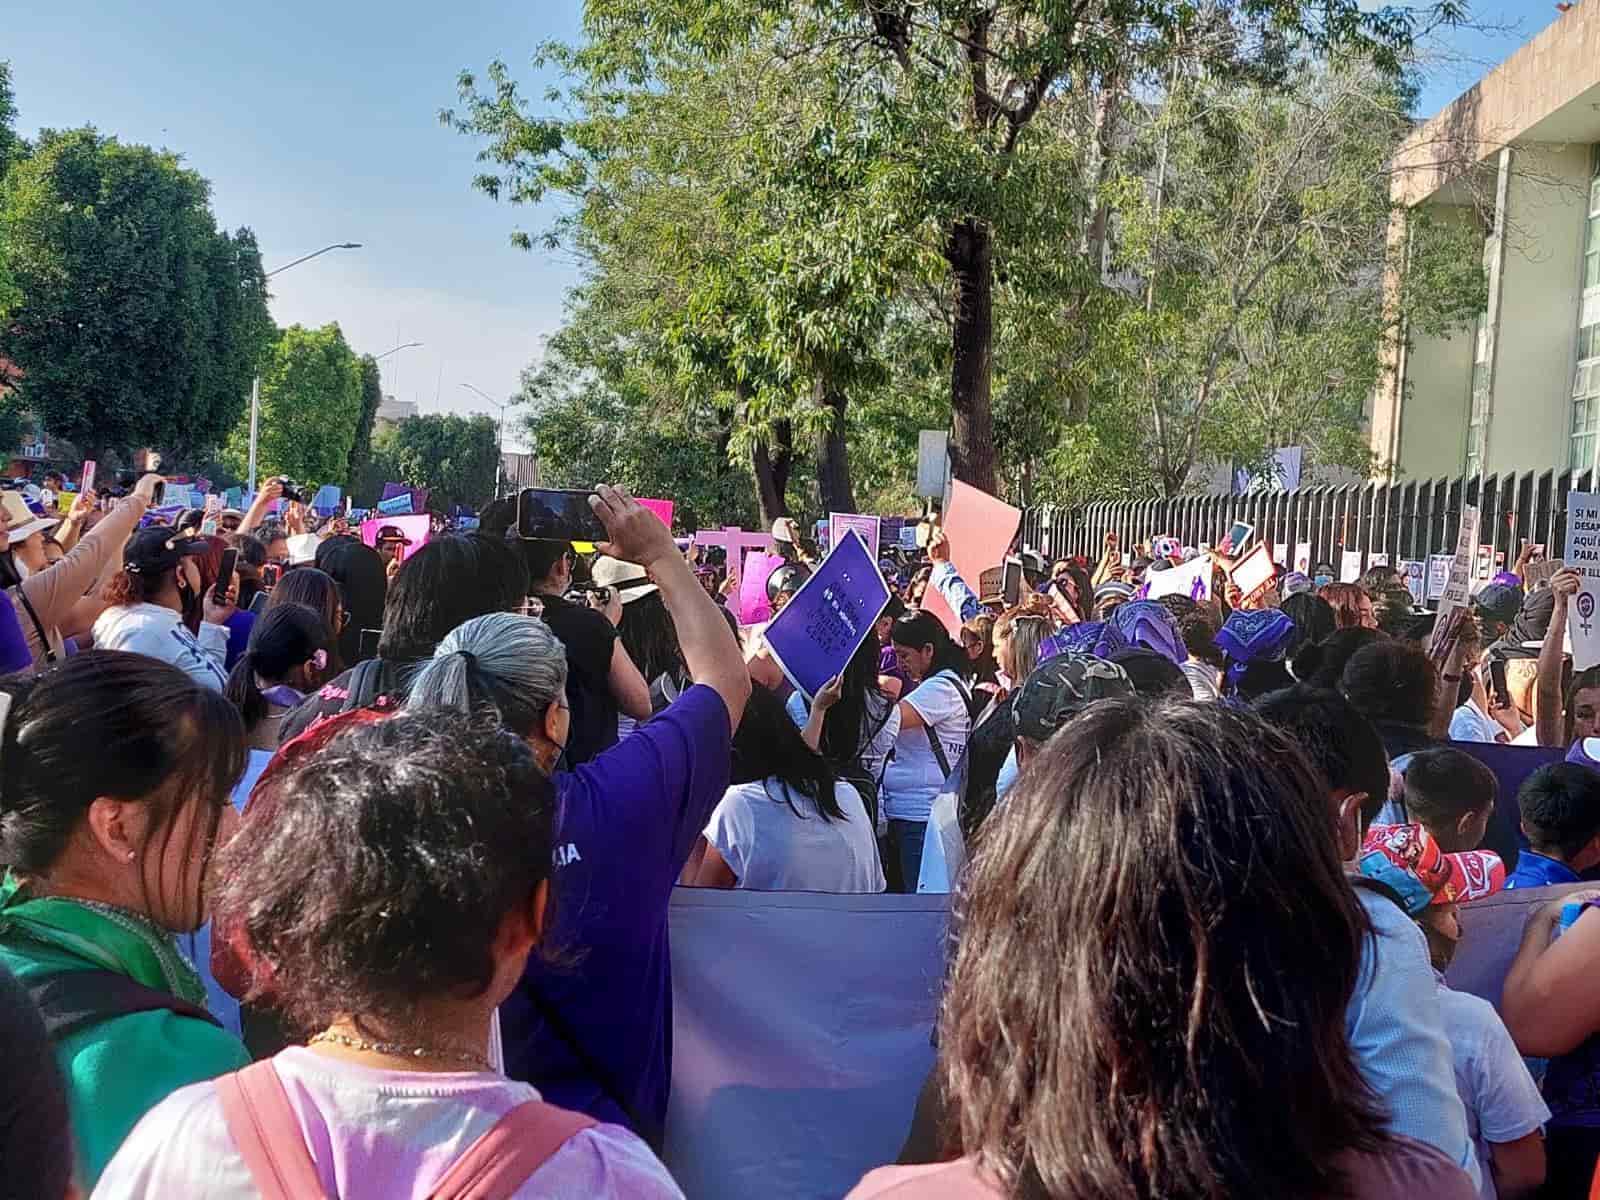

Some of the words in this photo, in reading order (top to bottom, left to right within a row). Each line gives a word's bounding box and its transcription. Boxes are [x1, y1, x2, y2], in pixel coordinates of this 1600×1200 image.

[1575, 509, 1584, 518] SI
[1586, 510, 1598, 519] MI
[1573, 536, 1596, 547] AQUÍ
[1573, 550, 1598, 560] PARA
